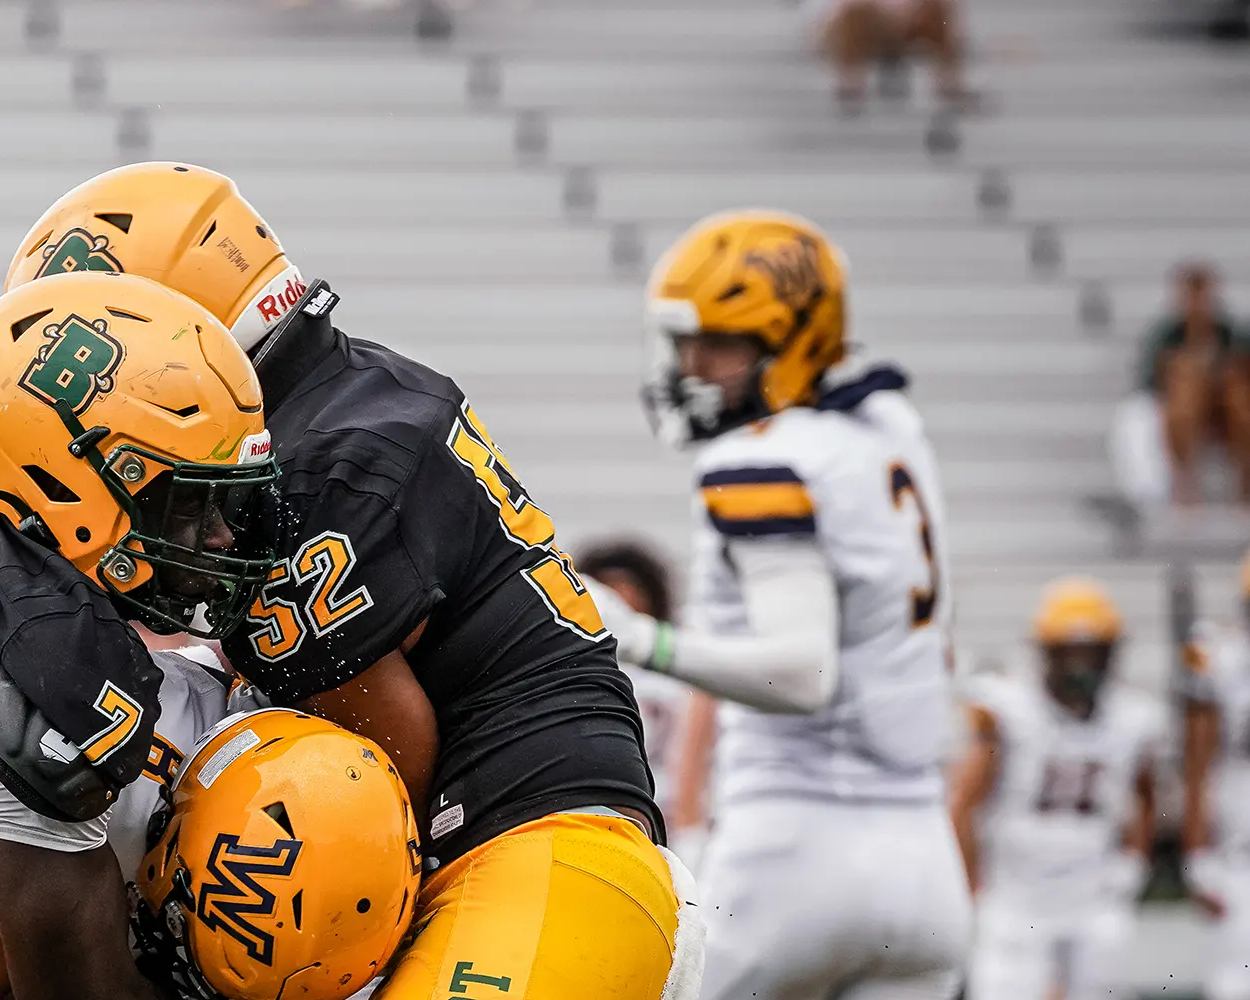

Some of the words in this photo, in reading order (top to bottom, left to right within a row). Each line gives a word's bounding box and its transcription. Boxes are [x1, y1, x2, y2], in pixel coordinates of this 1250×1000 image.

[17, 312, 125, 418] B
[246, 530, 375, 663] 52
[86, 679, 145, 767] 7
[440, 793, 449, 808] L
[197, 832, 304, 967] M
